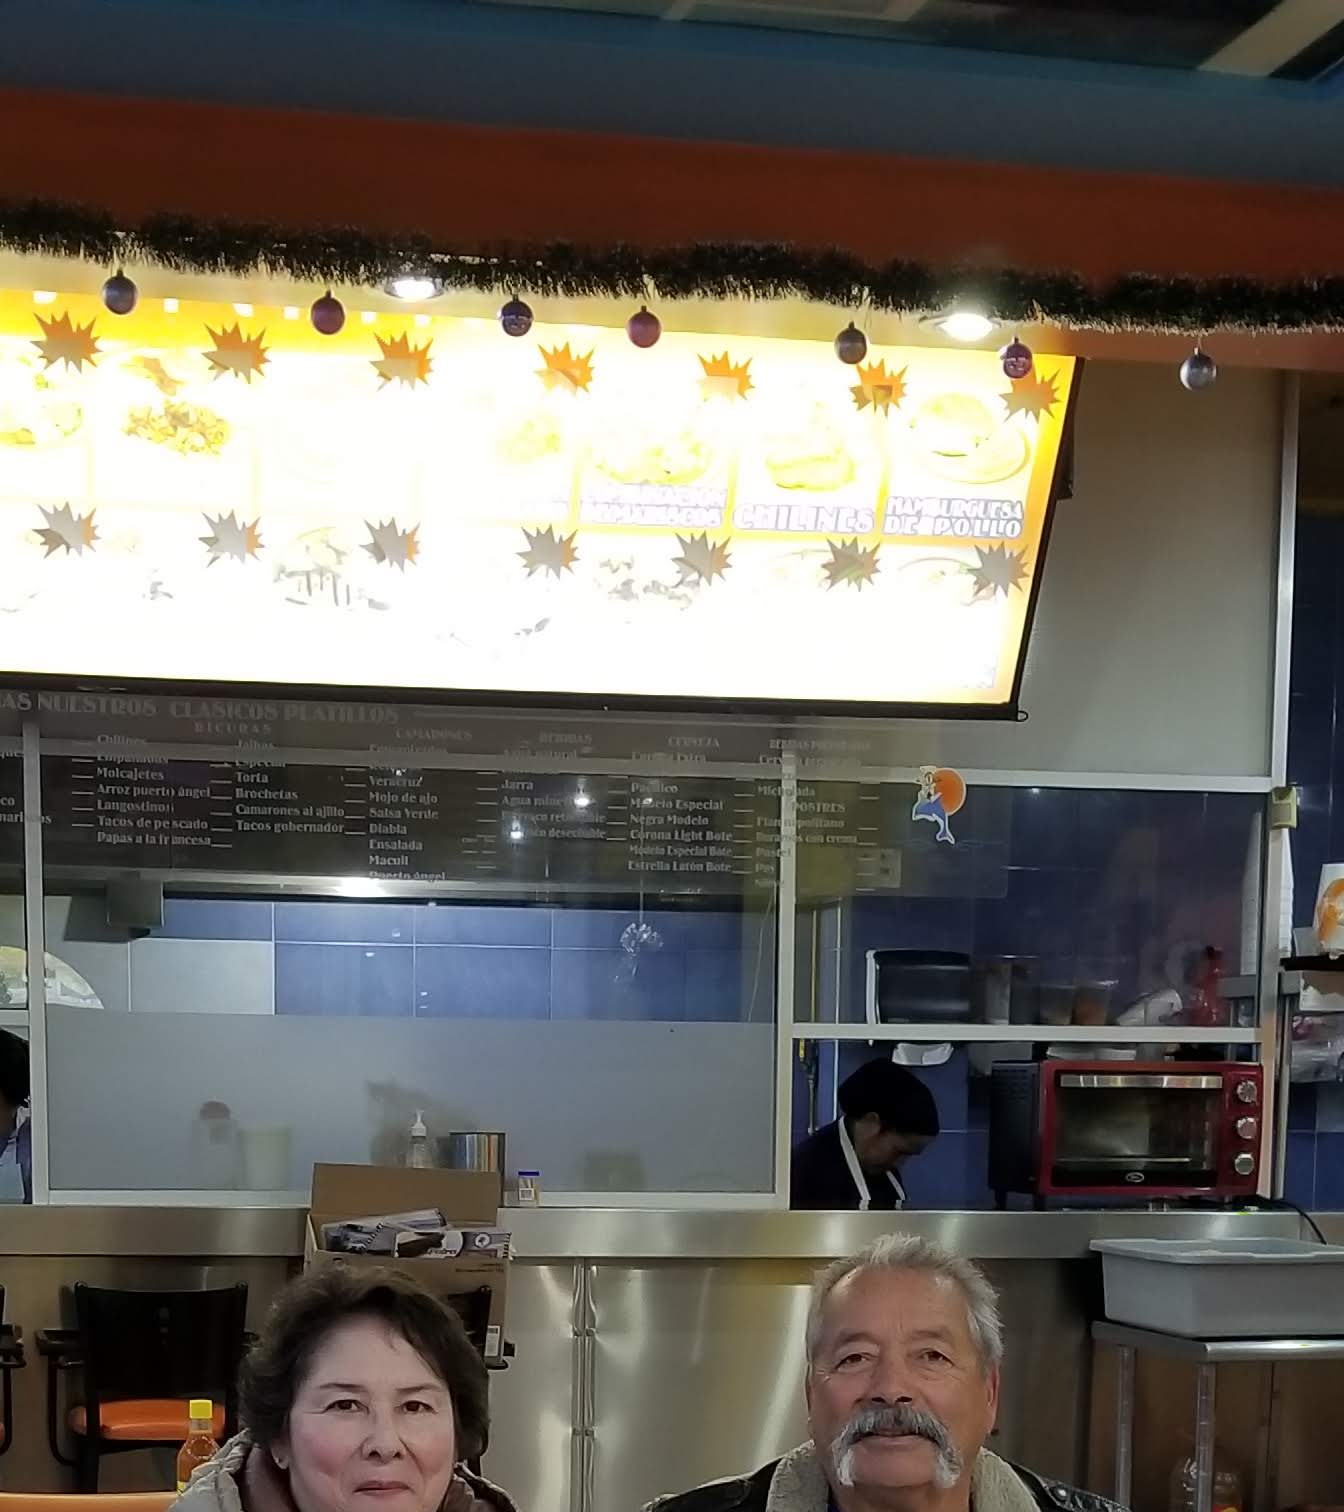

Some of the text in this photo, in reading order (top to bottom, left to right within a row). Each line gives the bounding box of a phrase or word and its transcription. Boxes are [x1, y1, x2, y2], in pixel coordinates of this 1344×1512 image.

[887, 496, 1023, 518] HAMBURGUESA
[733, 503, 874, 533] CHILINES
[934, 515, 1022, 539] POLLO
[37, 692, 158, 719] NUESTROS
[168, 699, 277, 721] CLASICOS
[283, 703, 399, 725] PLATILLOS
[97, 767, 165, 782] Molcajetes
[236, 771, 270, 784] Torta
[369, 775, 423, 788] Veracruz
[97, 783, 130, 796] Arroz
[502, 779, 535, 792] Jarra
[236, 786, 300, 801] Brochetas
[369, 790, 439, 806] Mojo de ajo
[236, 803, 300, 817] Camarones
[302, 805, 314, 817] al
[369, 807, 440, 821] Salsa Verde
[676, 799, 724, 814] Especial
[97, 815, 134, 829] Tacos
[136, 816, 152, 829] de
[236, 819, 345, 836] Tacos gobernador
[630, 813, 710, 828] Negra Modelo
[369, 823, 408, 837] Diabla
[630, 828, 734, 844] Corona Light Bote
[97, 831, 134, 846] Papas
[369, 839, 423, 853] Ensalada
[667, 845, 707, 860] Especial
[708, 845, 733, 859] Bote
[369, 855, 410, 868] Macuil
[628, 860, 671, 874] Estrella
[705, 862, 733, 874] Bote
